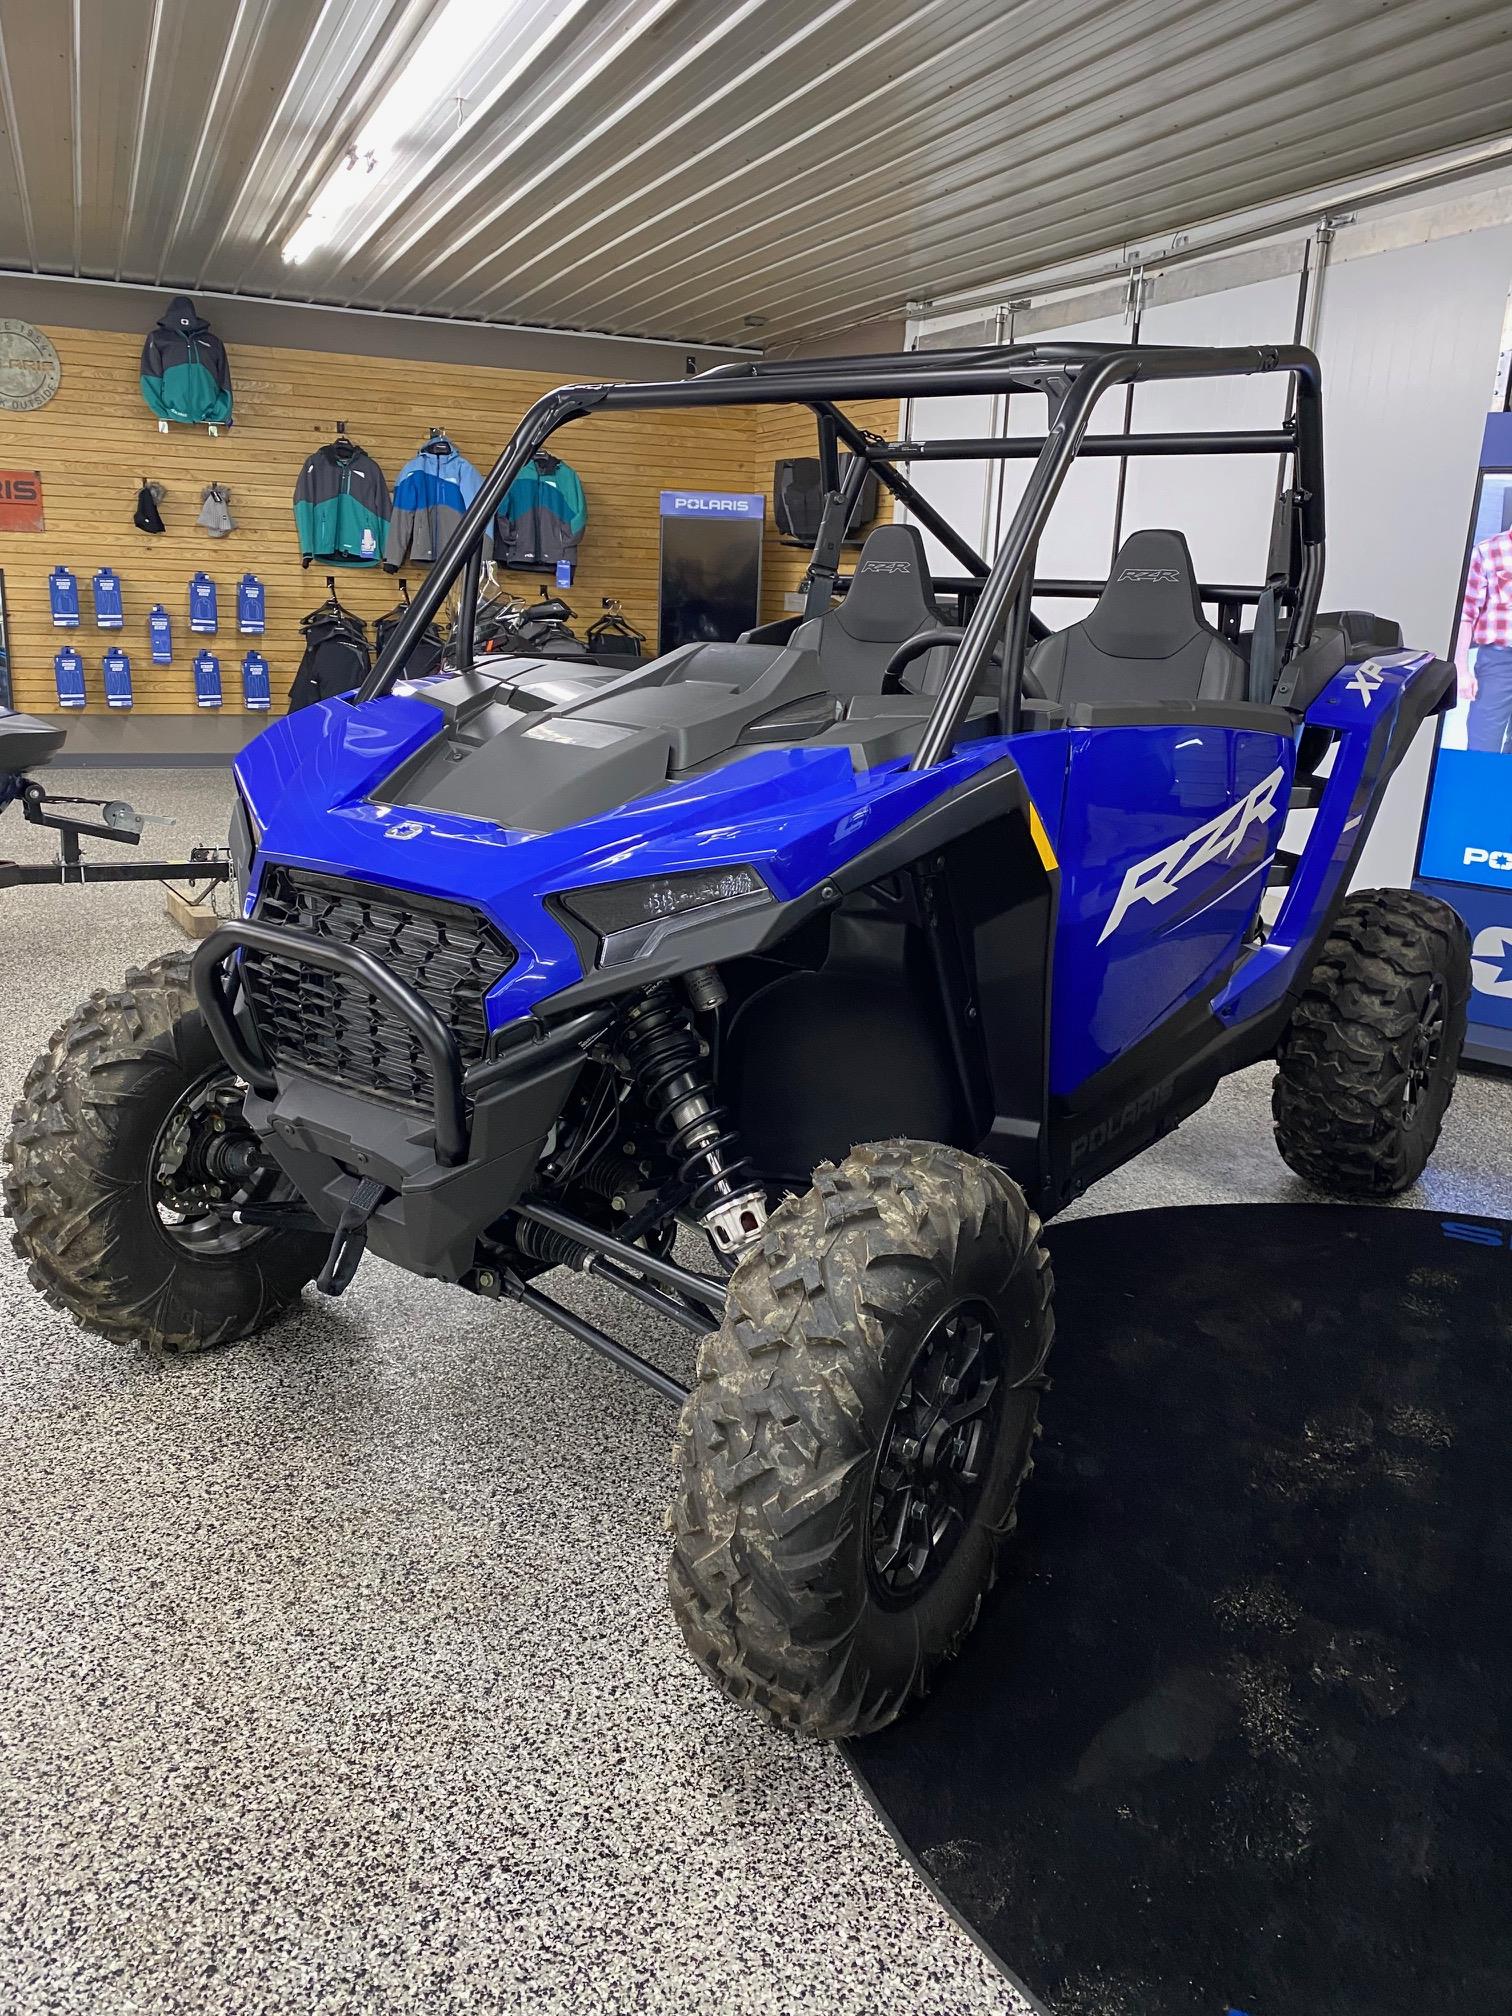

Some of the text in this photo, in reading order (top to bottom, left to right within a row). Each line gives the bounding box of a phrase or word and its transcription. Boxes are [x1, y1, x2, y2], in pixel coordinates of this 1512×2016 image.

[12, 383, 57, 410] OUTSIDE
[0, 479, 37, 500] IS
[674, 498, 749, 511] POLARIS
[861, 560, 911, 573] RZR
[1117, 568, 1180, 582] RZR
[1345, 660, 1385, 708] XP
[1096, 766, 1285, 946] RZR
